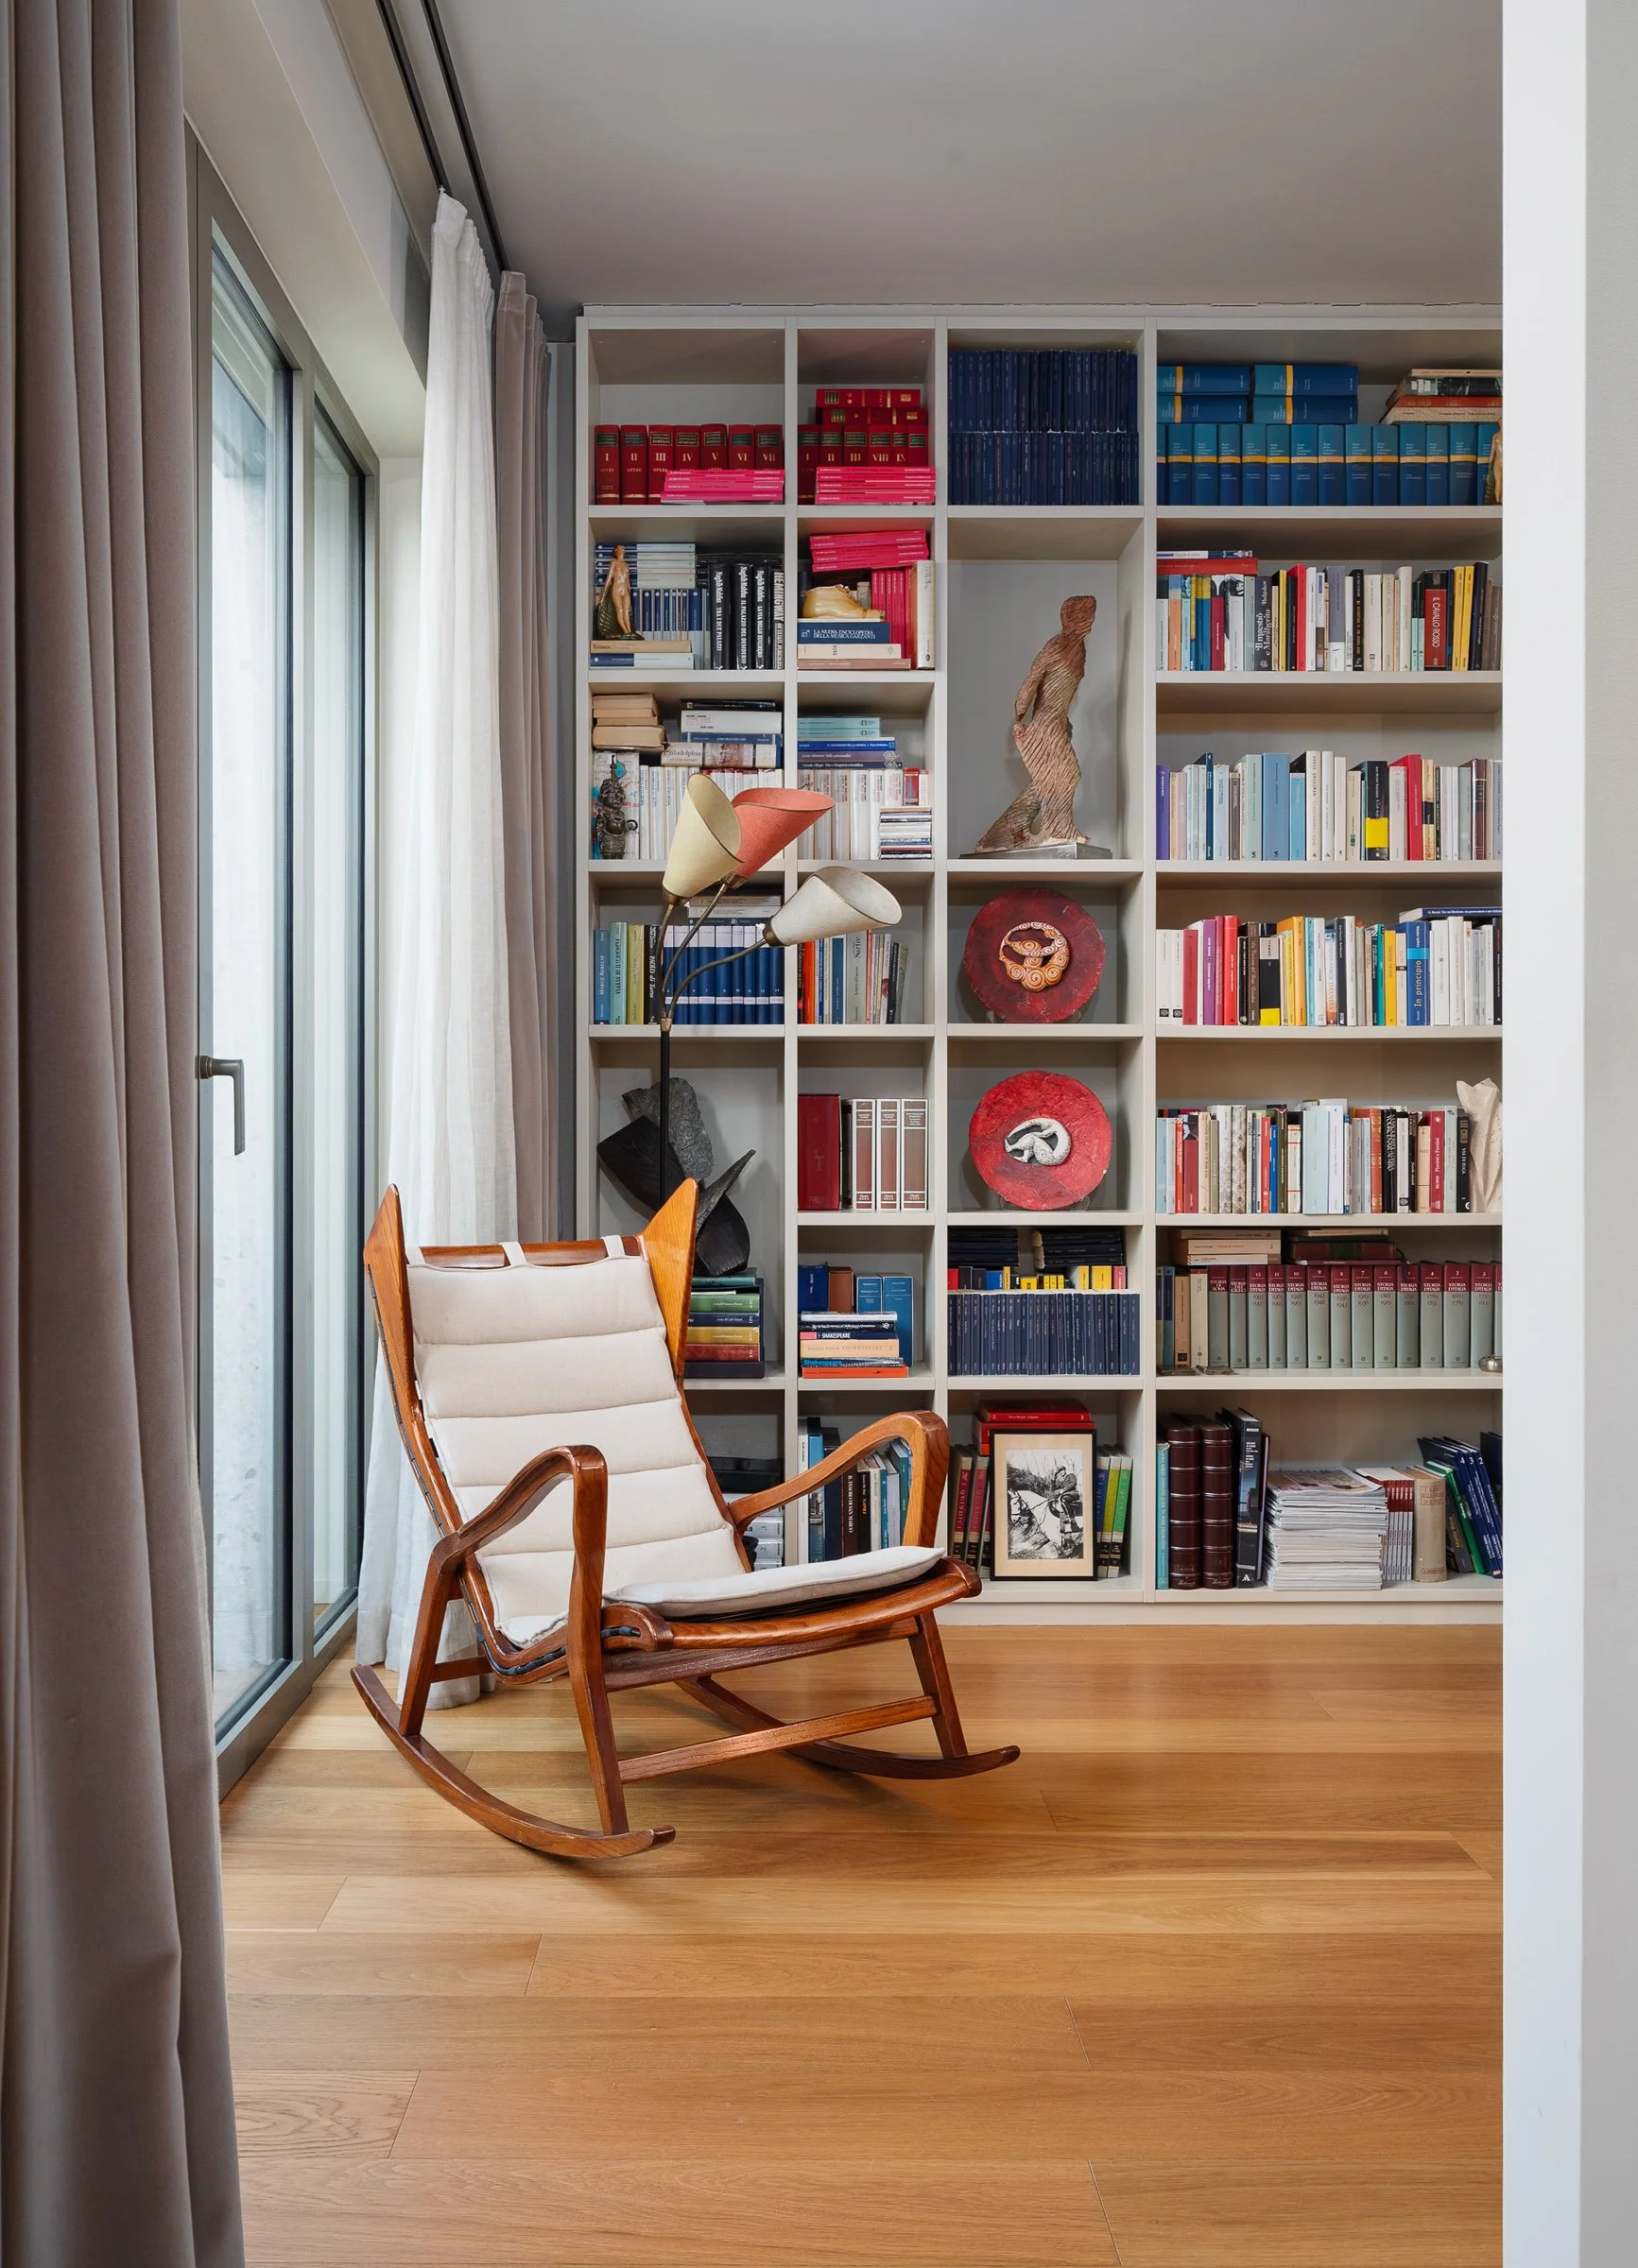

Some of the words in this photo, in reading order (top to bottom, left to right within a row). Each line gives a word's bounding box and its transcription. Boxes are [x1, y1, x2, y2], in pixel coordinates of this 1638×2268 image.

[605, 453, 609, 461] I
[630, 453, 638, 461] II
[655, 453, 666, 461] III
[682, 453, 693, 461] IV
[712, 453, 718, 461] V
[737, 453, 748, 461] VI
[763, 453, 776, 461] VII
[773, 572, 785, 622] HEMINGWAY
[1432, 602, 1440, 627] CAVALLO
[1255, 612, 1265, 642] maestro
[1432, 628, 1440, 648] ROSSO
[1414, 960, 1423, 996] principio
[1414, 999, 1422, 1007] In
